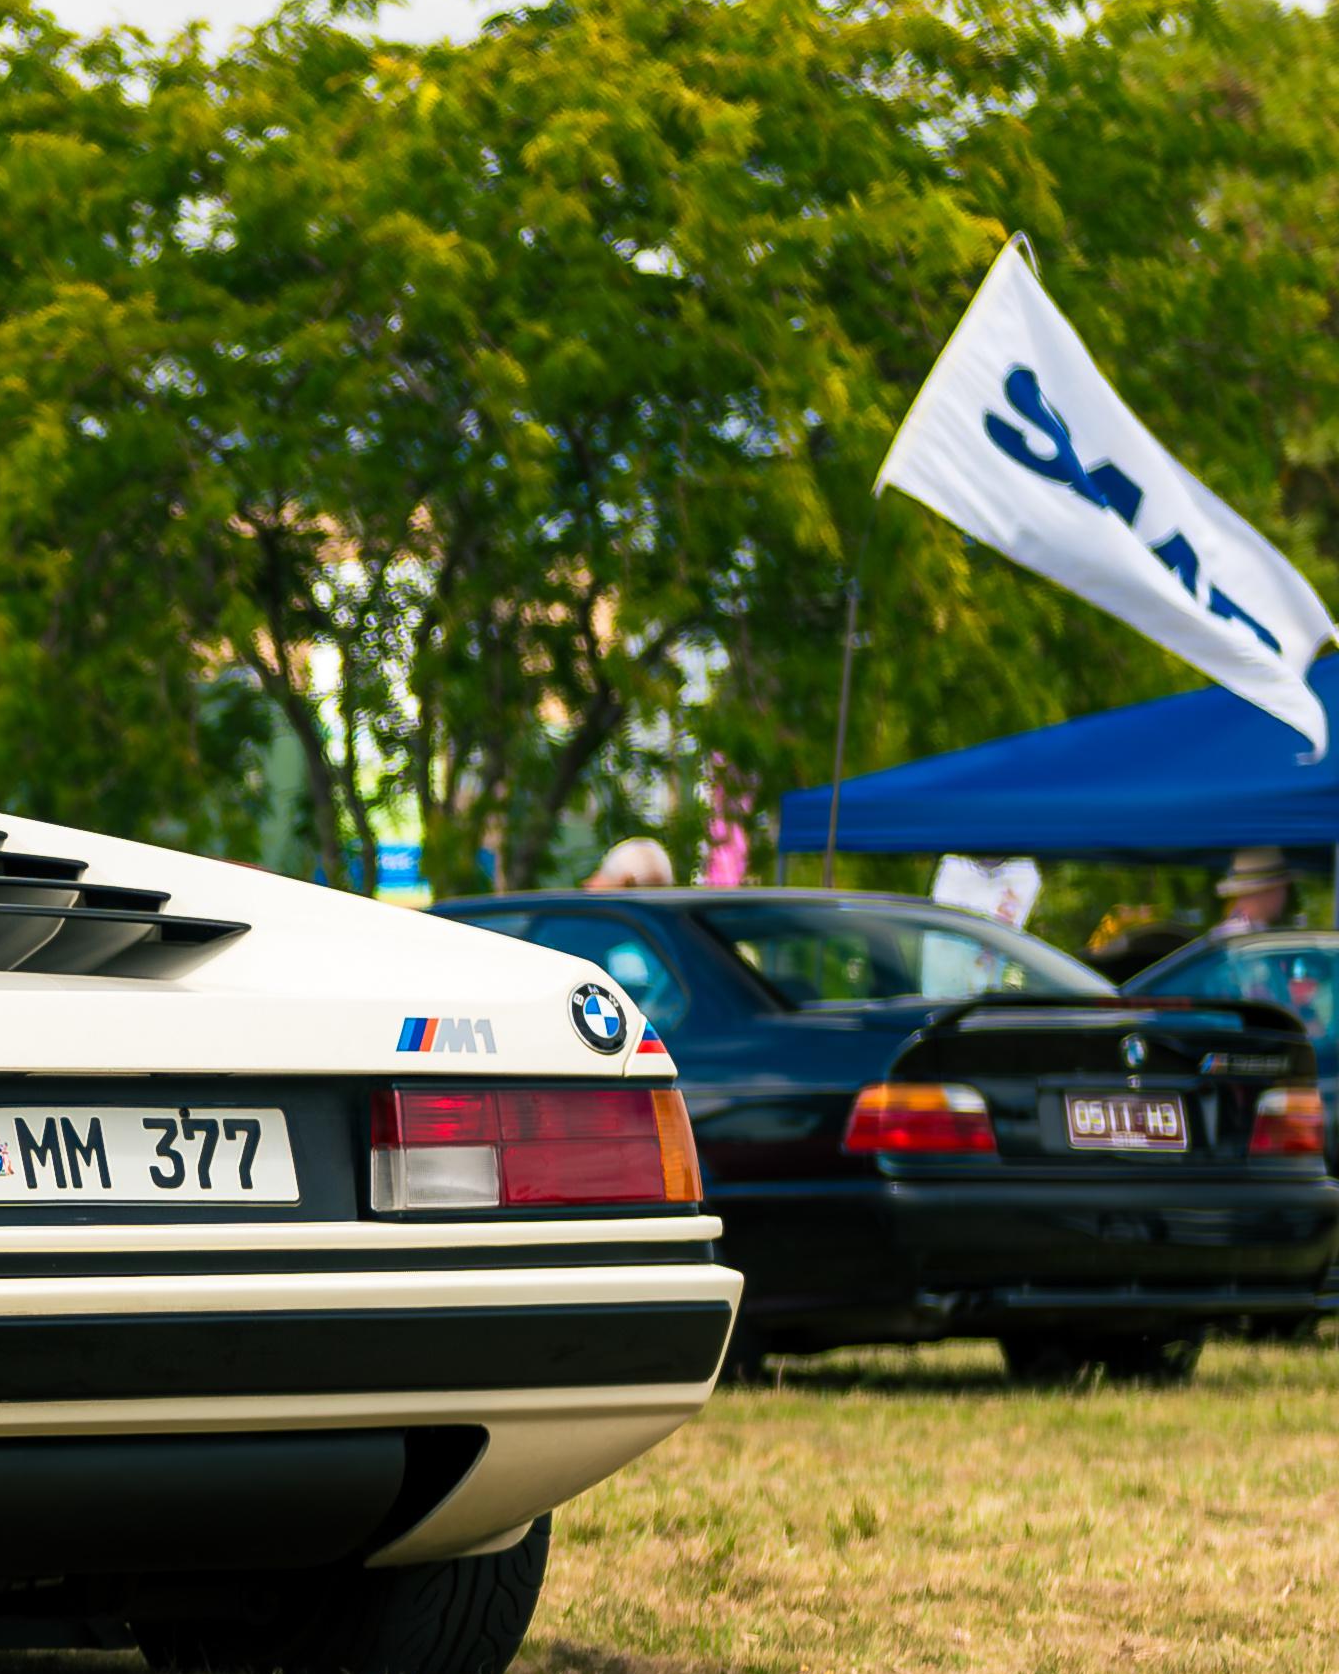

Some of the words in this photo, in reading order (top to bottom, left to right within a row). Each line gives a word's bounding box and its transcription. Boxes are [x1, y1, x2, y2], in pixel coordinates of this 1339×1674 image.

[573, 984, 620, 1008] BMW
[432, 1017, 498, 1054] M1
[14, 1117, 112, 1189] MM
[142, 1117, 261, 1190] 377
